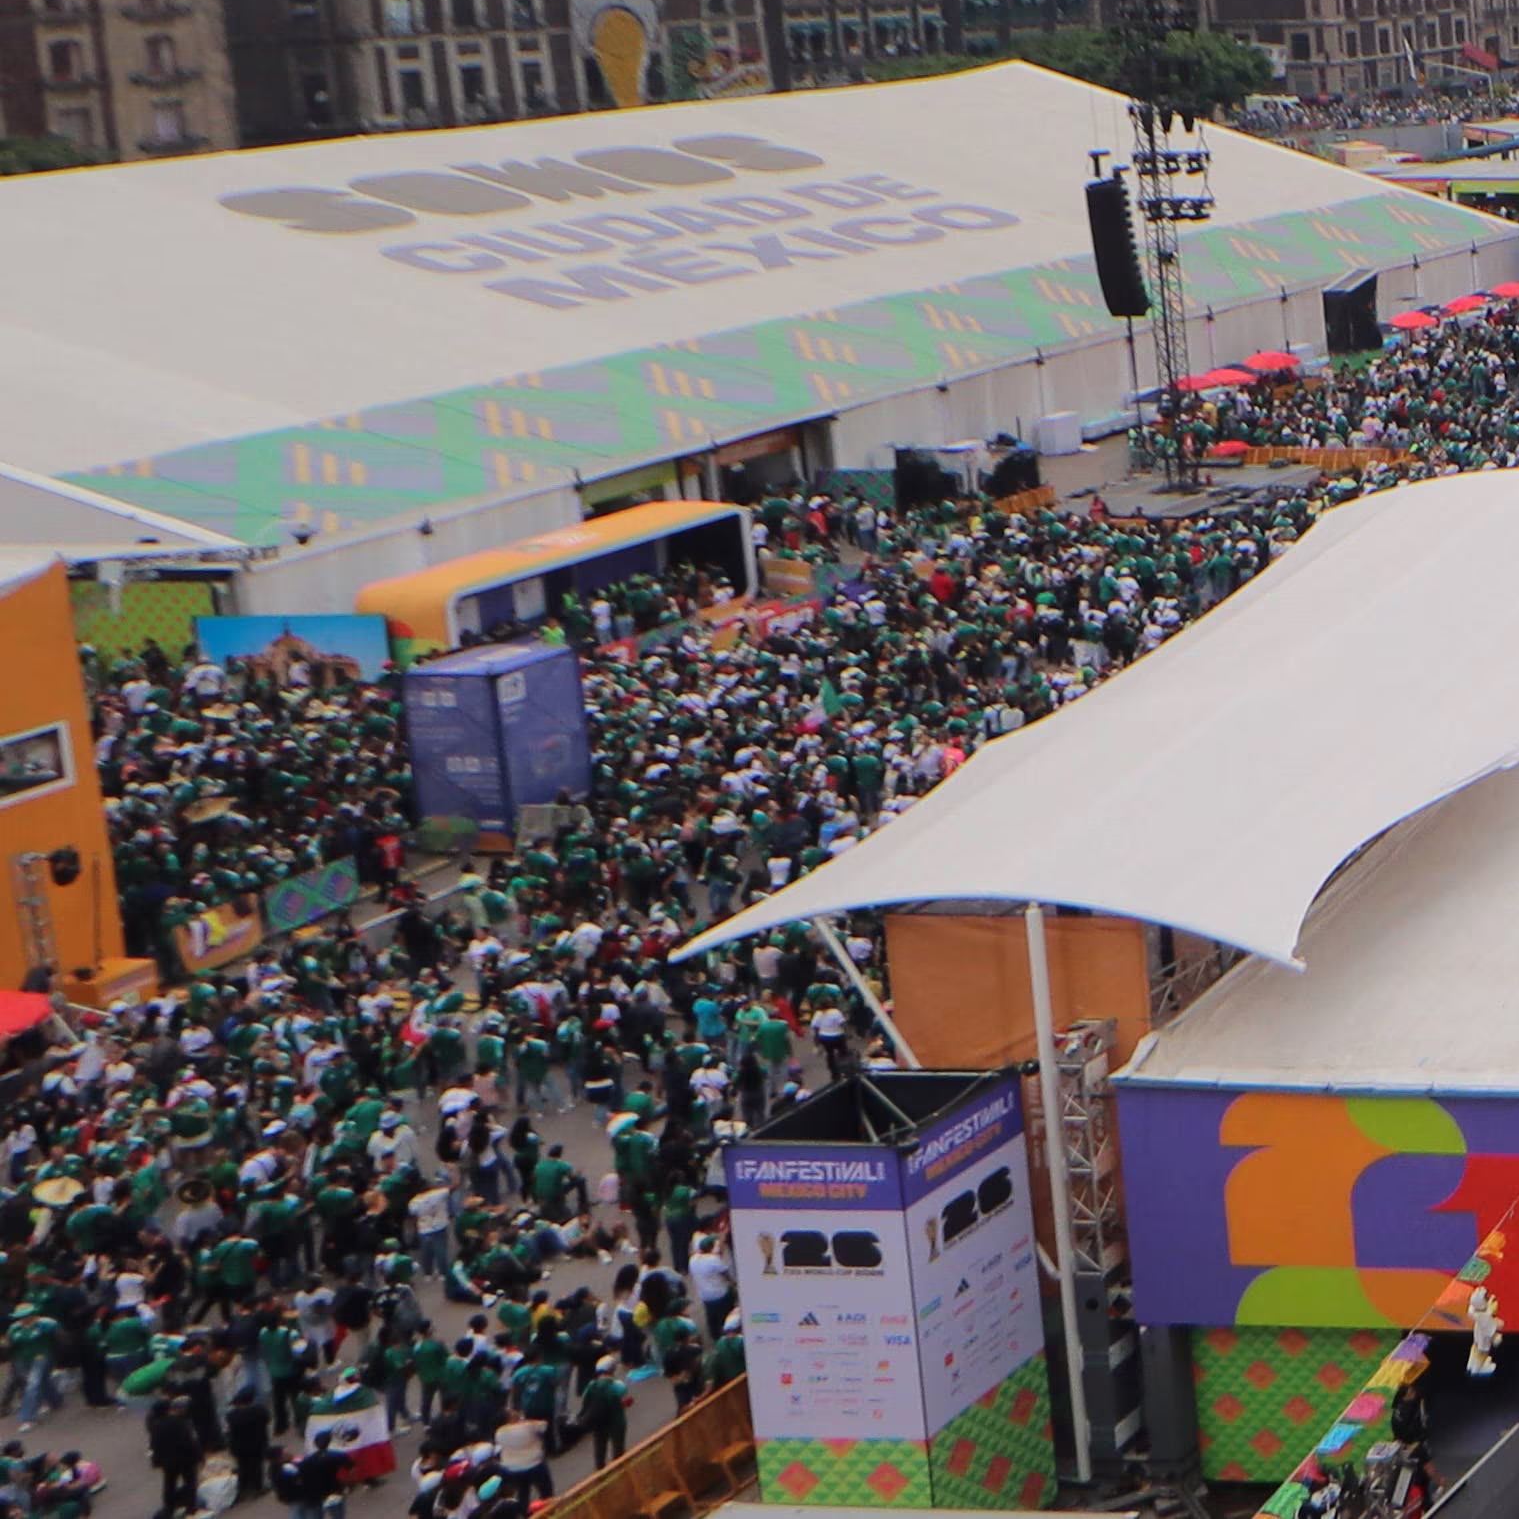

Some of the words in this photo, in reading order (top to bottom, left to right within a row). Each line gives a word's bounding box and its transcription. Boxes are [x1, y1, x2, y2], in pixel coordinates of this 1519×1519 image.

[216, 133, 826, 235] SOMOS
[379, 194, 814, 273] CIUDAD
[782, 174, 942, 210] DE
[482, 202, 1021, 310] MÉXICO
